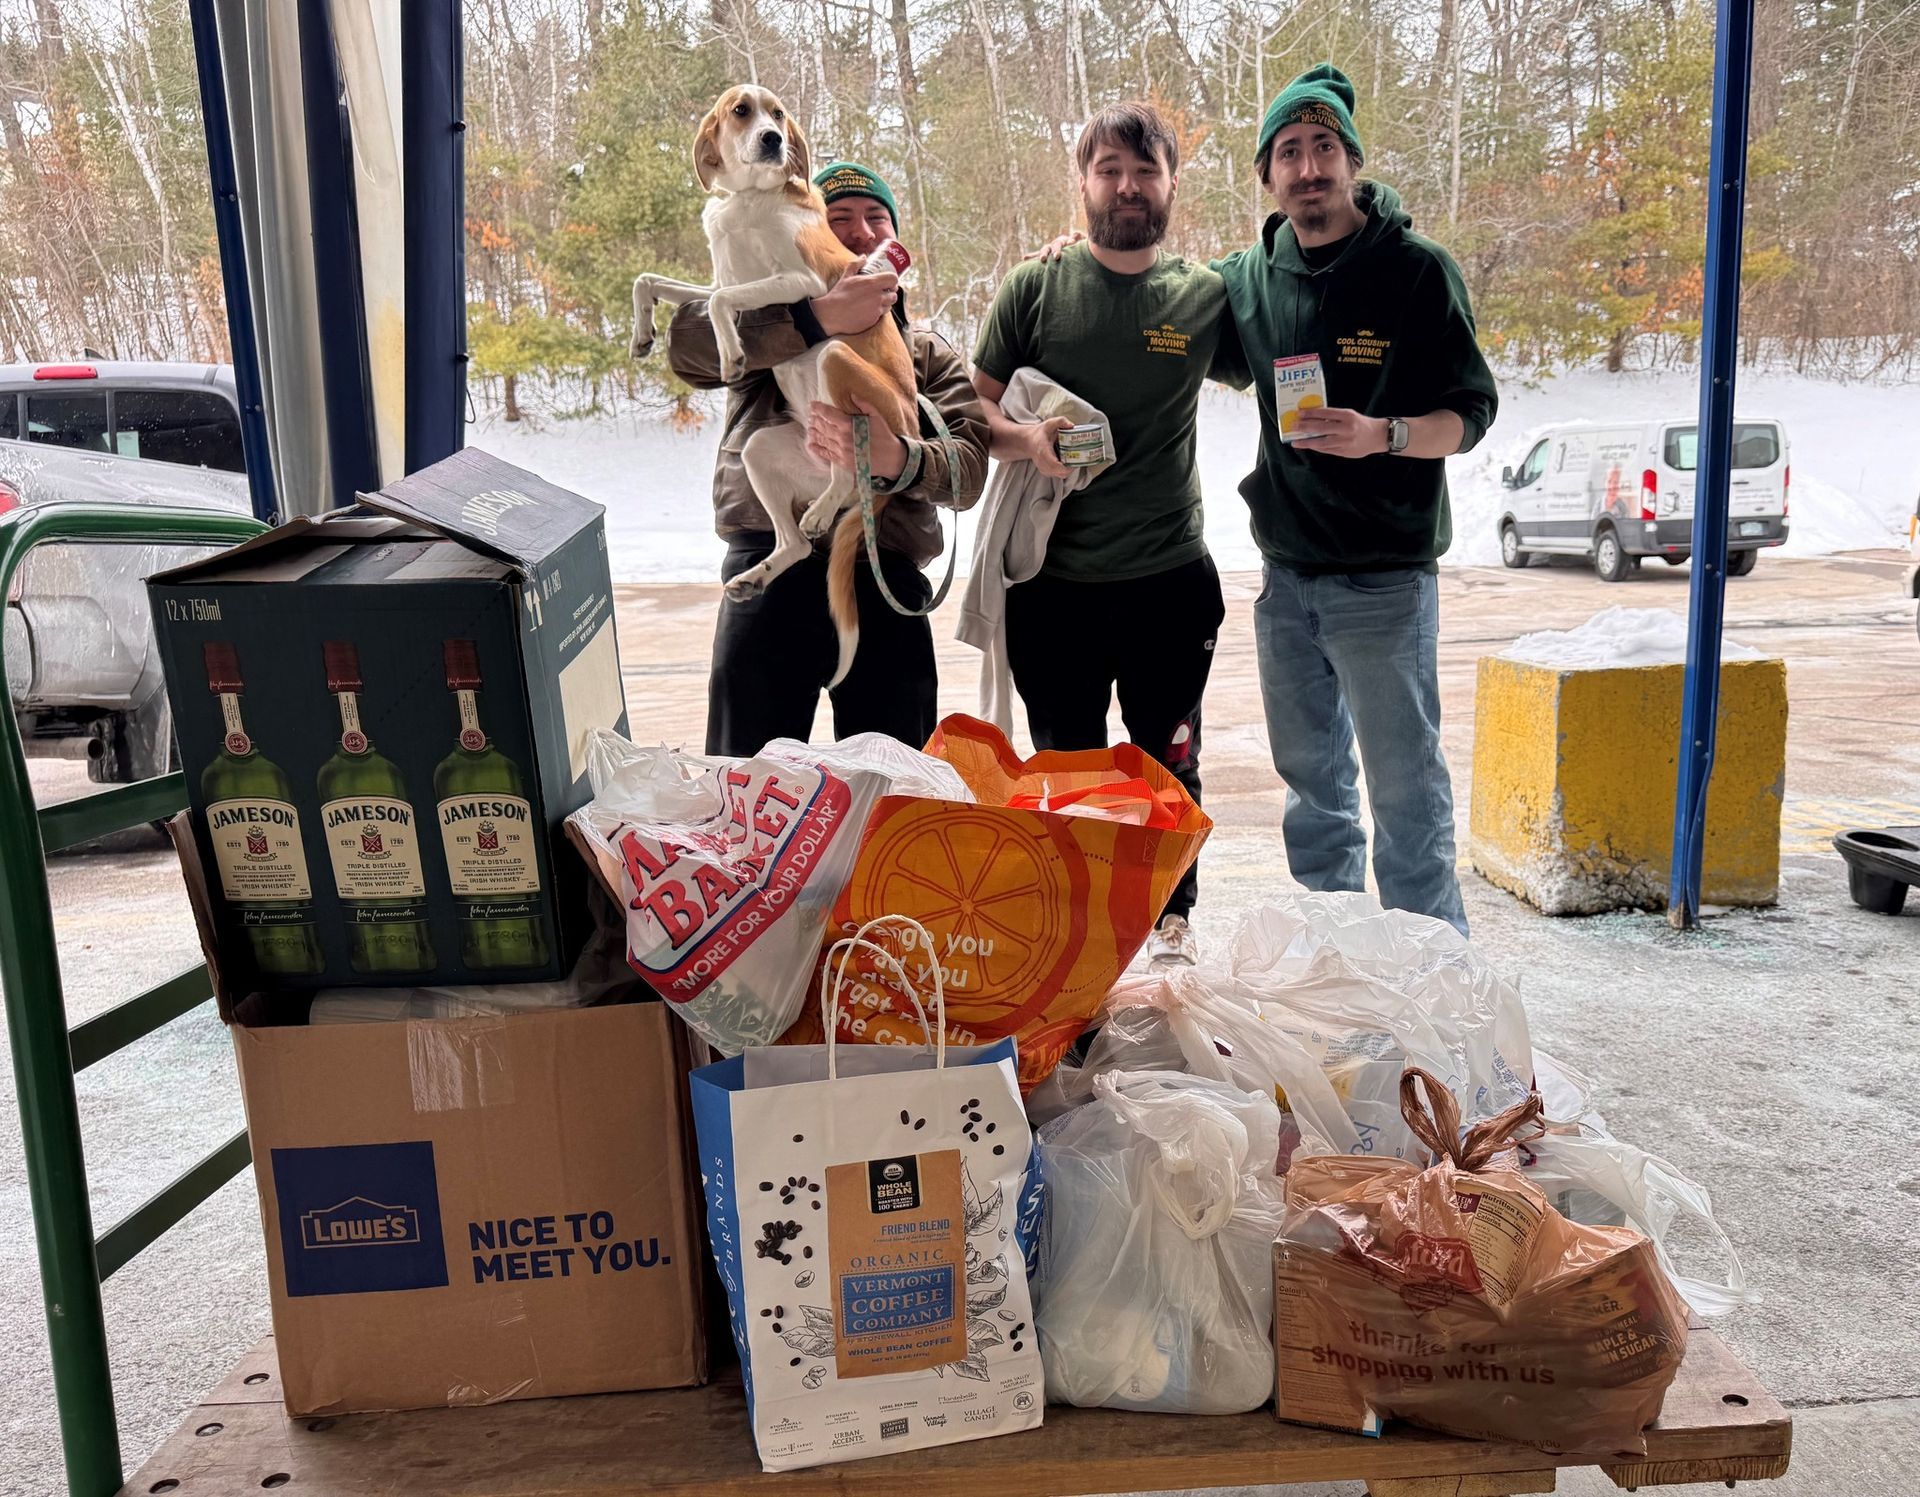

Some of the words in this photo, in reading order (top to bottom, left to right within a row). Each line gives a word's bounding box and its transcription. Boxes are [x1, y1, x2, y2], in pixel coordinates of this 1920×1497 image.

[1290, 107, 1313, 118] COOL
[1301, 113, 1339, 131] MOVING
[827, 178, 867, 190] MOVING
[1150, 337, 1186, 349] MOVING
[1342, 346, 1382, 358] MOVING
[1357, 338, 1391, 348] COUSIN'S
[1278, 368, 1317, 383] JIFFY
[462, 489, 540, 537] JAMESON
[165, 600, 180, 621] 12
[182, 606, 189, 621] x
[188, 599, 222, 621] 750ml
[213, 807, 294, 830] JAMESON
[328, 805, 409, 828] JAMESON
[444, 802, 526, 825] JAMESON
[727, 909, 767, 946] FOR
[757, 864, 801, 914] YOUR
[841, 921, 935, 952] oange
[946, 931, 994, 958] you
[917, 963, 968, 988] you
[874, 1028, 925, 1047] ca
[949, 1024, 977, 1047] in
[877, 1180, 912, 1190] WHOLE
[877, 1187, 913, 1198] BEAN
[1457, 1195, 1473, 1204] TEIN
[714, 1157, 734, 1264] BRANDS
[1482, 1193, 1516, 1214] Nutrition
[1516, 1210, 1532, 1227] Facts
[313, 1214, 408, 1243] LOWE'S
[881, 1222, 917, 1236] FRIEND
[919, 1218, 950, 1232] BLEND
[1476, 1212, 1502, 1228] Calories
[468, 1216, 558, 1251] NICE
[564, 1210, 615, 1243] TO
[472, 1249, 575, 1284] MEET
[582, 1238, 672, 1275] YOU.
[850, 1248, 944, 1269] ORGANIC
[723, 1263, 737, 1293] of
[851, 1272, 945, 1294] VERMONT
[851, 1288, 945, 1315] COFFEE
[852, 1305, 944, 1331] COMPANY
[856, 1331, 912, 1343] STONEWALL
[914, 1322, 953, 1336] KITCHEN
[1627, 1329, 1638, 1340] &
[847, 1346, 883, 1357] WHOLE
[886, 1341, 913, 1352] BEAN
[916, 1336, 953, 1349] COFFEE
[1619, 1334, 1659, 1359] SUGAR
[1311, 1343, 1434, 1384] shopping
[1442, 1358, 1510, 1383] with
[1518, 1367, 1556, 1385] us
[938, 1391, 978, 1402] Montebello
[825, 1410, 857, 1419] STONEWALL
[923, 1413, 946, 1423] Vermont
[964, 1405, 996, 1417] VILLAGE
[964, 1413, 997, 1423] CANDLE
[770, 1420, 802, 1429] STONEWALL
[775, 1424, 799, 1432] KITCHEN
[926, 1419, 948, 1428] Village
[832, 1435, 864, 1446] ACCENTS
[834, 1429, 861, 1439] URBAN
